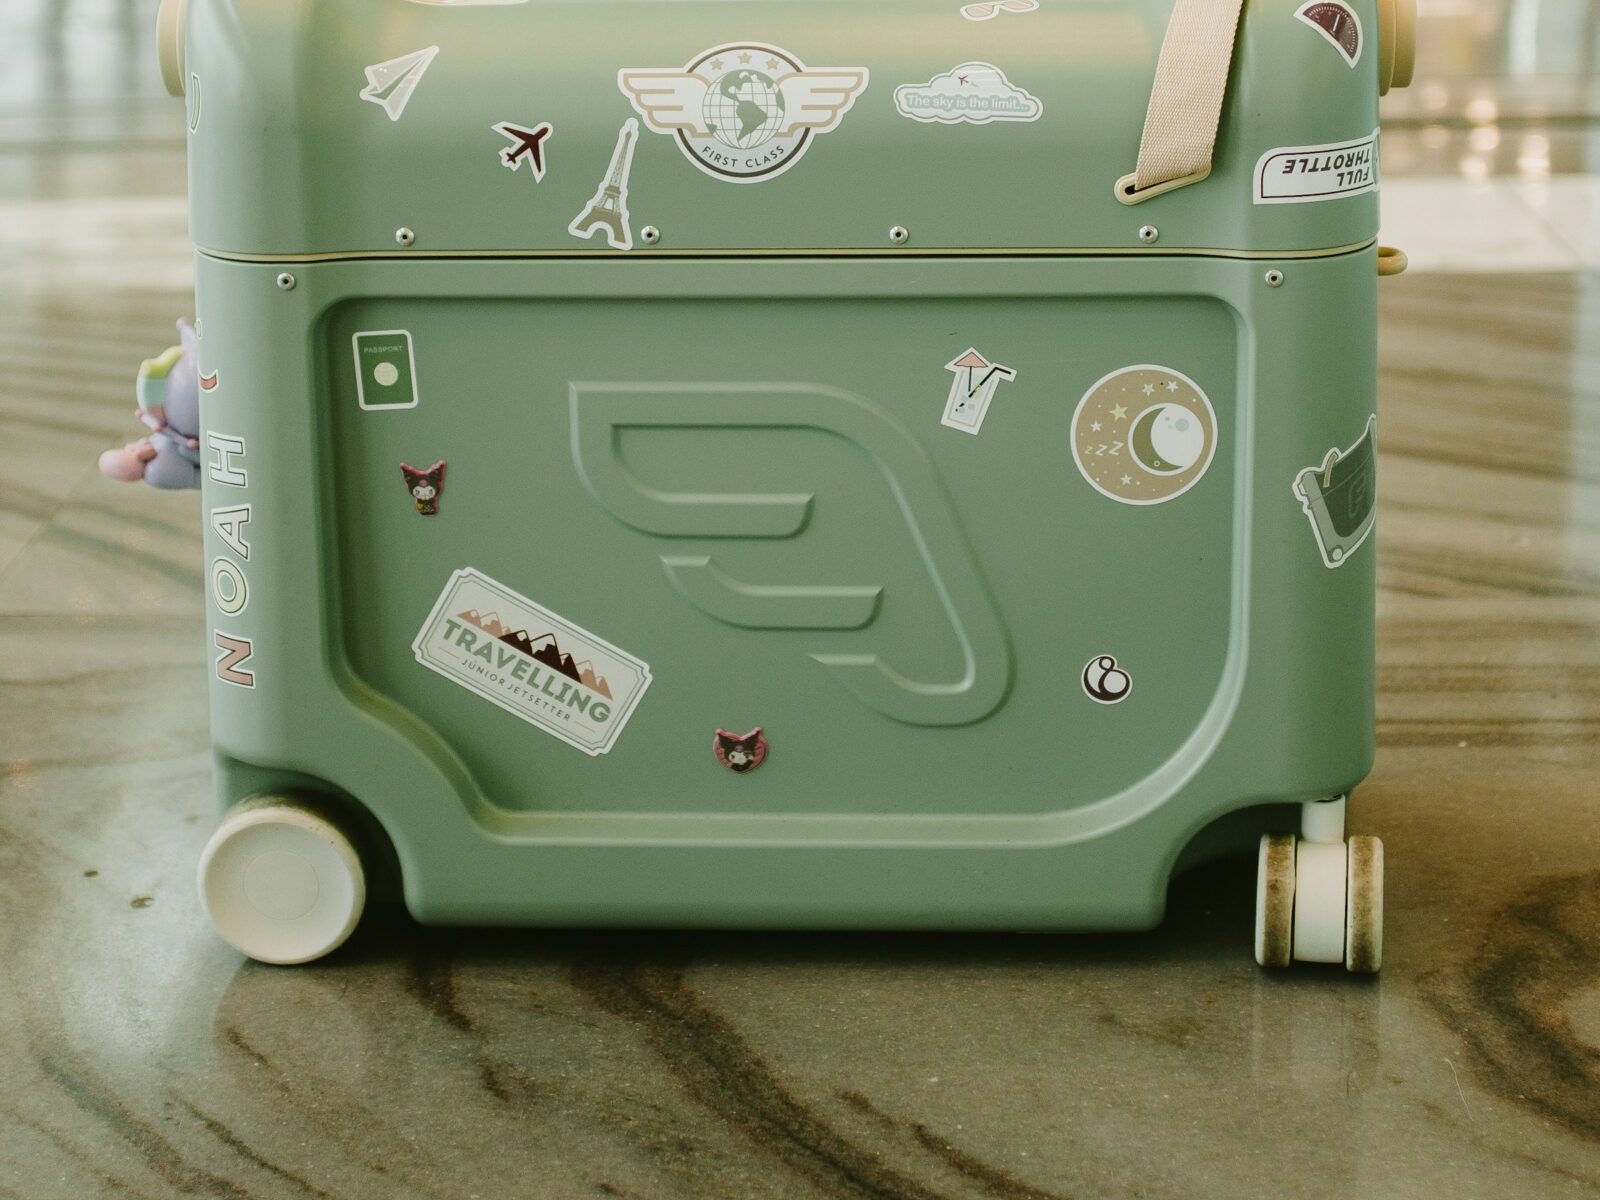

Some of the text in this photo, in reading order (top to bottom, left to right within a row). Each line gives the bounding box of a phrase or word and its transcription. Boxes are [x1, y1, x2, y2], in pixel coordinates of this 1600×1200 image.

[907, 94, 929, 106] The
[933, 95, 952, 110] sky
[956, 96, 966, 107] is
[970, 96, 986, 108] the
[702, 145, 784, 168] FIRST CLASS
[1282, 148, 1370, 174] THROTTLE
[1337, 166, 1370, 187] FULL
[364, 345, 403, 353] PASSPORT
[207, 431, 254, 688] NOAH
[442, 619, 611, 723] TRAVELLING
[461, 659, 571, 722] JUNIOR JETSETTER
